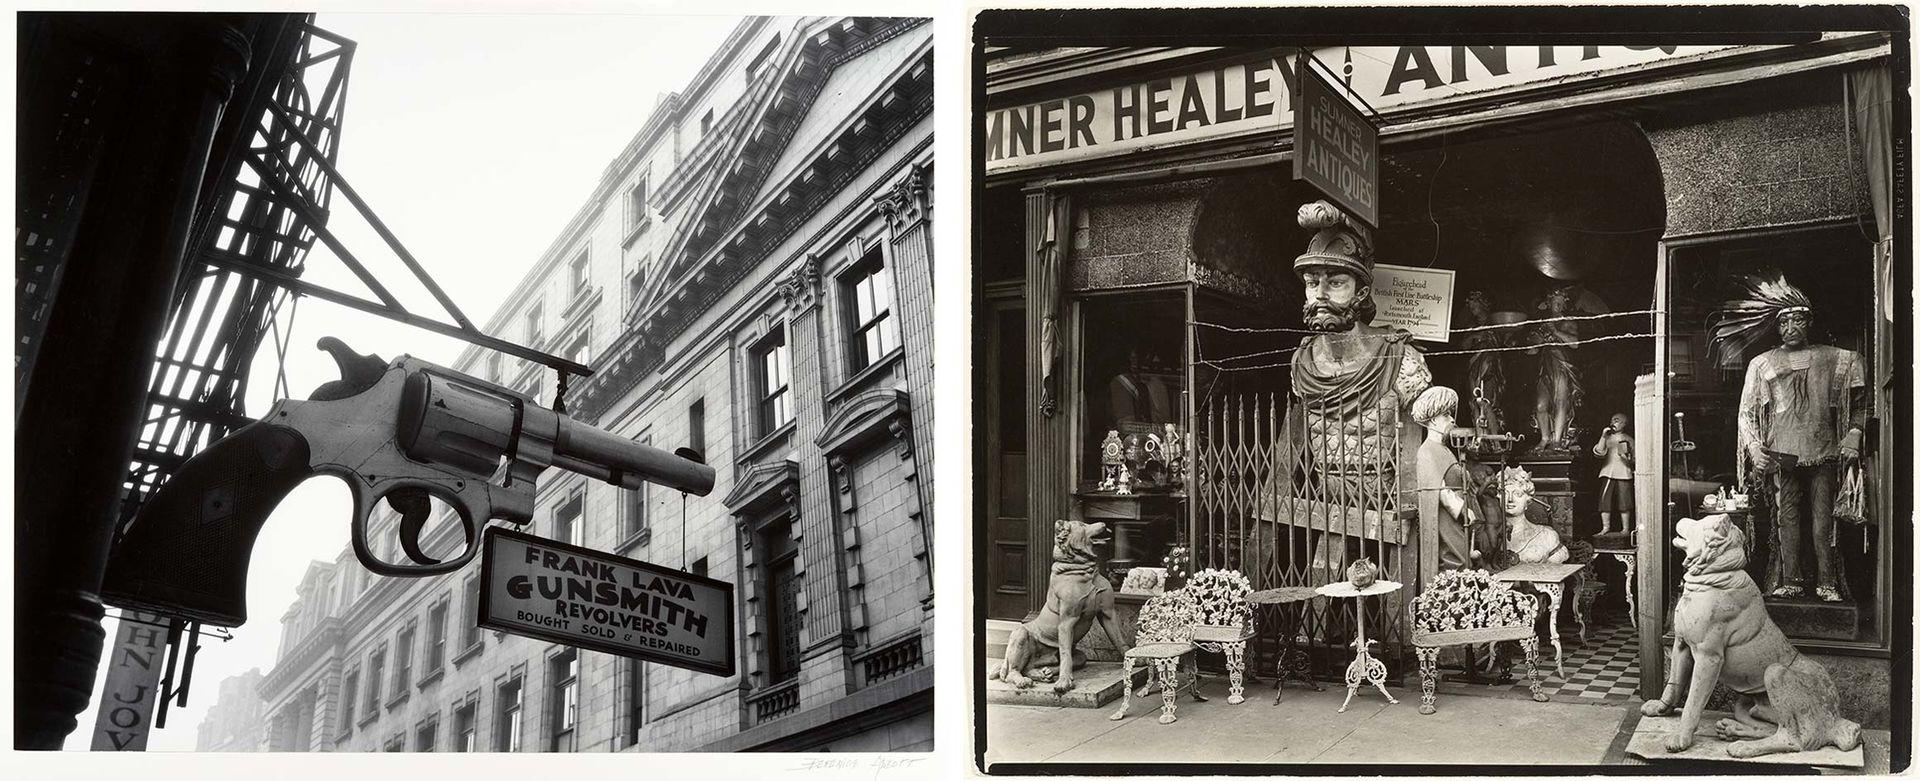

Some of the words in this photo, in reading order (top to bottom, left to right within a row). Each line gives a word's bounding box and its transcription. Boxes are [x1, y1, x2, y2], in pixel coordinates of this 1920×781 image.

[1114, 57, 1296, 142] HEALEY
[1320, 96, 1361, 139] SUMNER
[1311, 105, 1369, 171] HEALEY
[1307, 139, 1371, 208] ANTIQUES
[1395, 298, 1419, 306] MARS
[525, 547, 617, 582] FRANK
[633, 572, 695, 601] LAVA
[506, 575, 708, 639] GUNSMITH
[517, 611, 569, 630] BOUGHT
[581, 624, 615, 640] SOLD
[624, 633, 632, 642] &
[640, 635, 700, 657] REPAIRED
[556, 600, 668, 637] REVOLVERS
[105, 685, 148, 750] JOV
